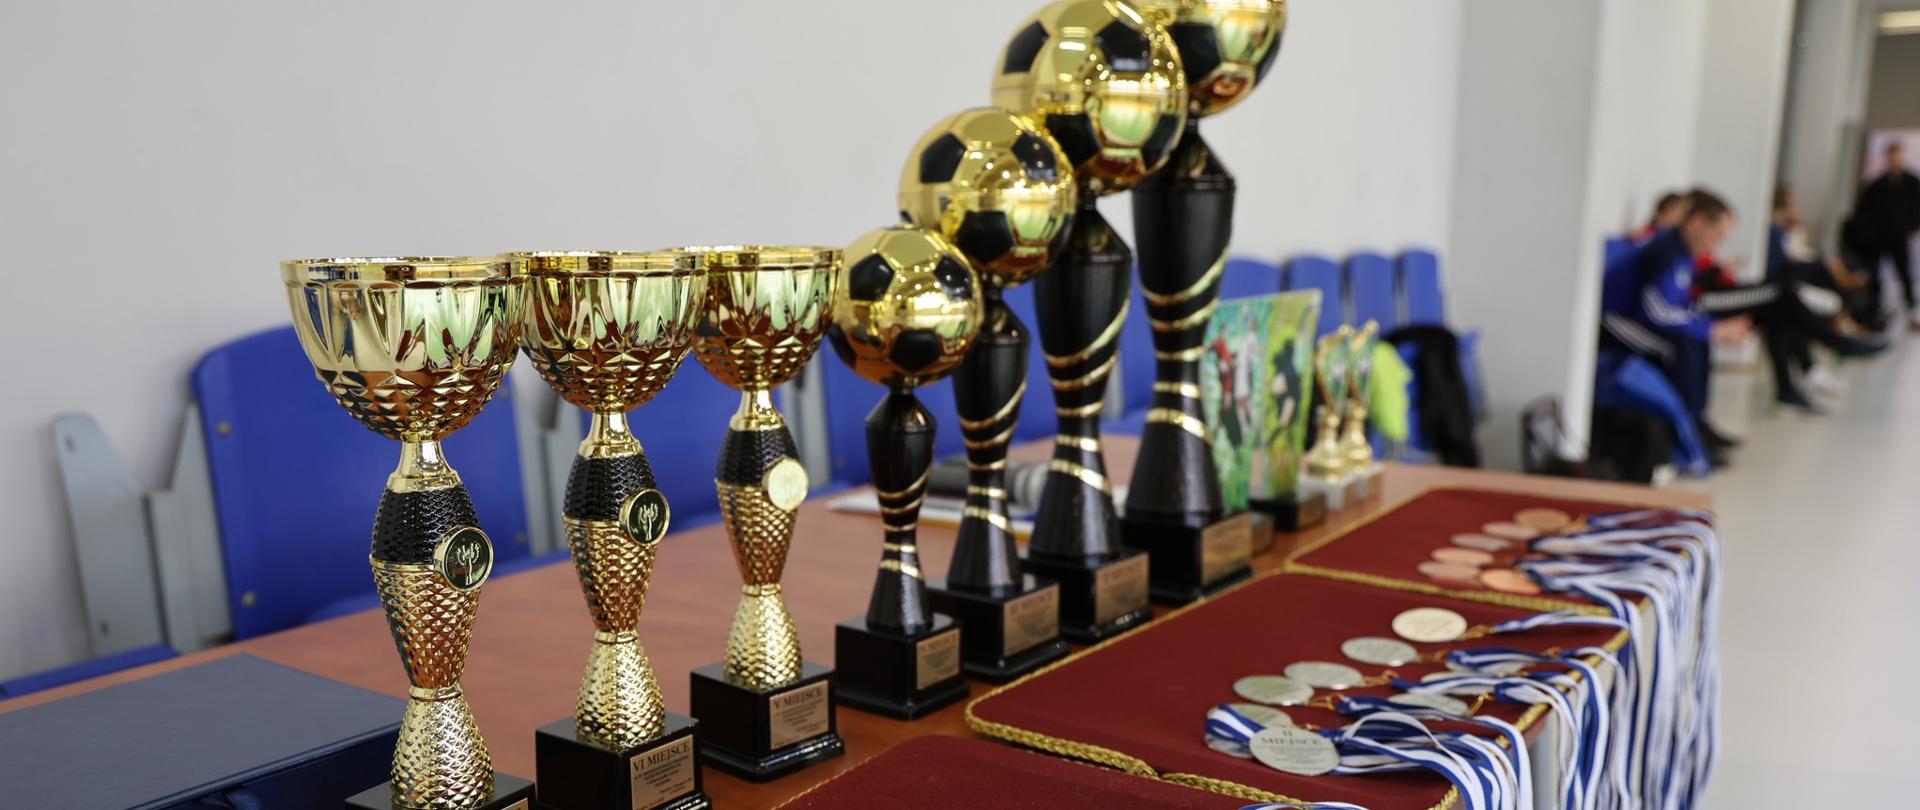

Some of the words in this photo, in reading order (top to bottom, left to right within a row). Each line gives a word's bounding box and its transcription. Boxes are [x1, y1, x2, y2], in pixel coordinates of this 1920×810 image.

[773, 699, 782, 709] V
[783, 688, 824, 705] MIEJSCE
[1261, 737, 1320, 745] MIEJSCE
[633, 758, 645, 771] VI
[647, 742, 690, 766] MIEJSCE
